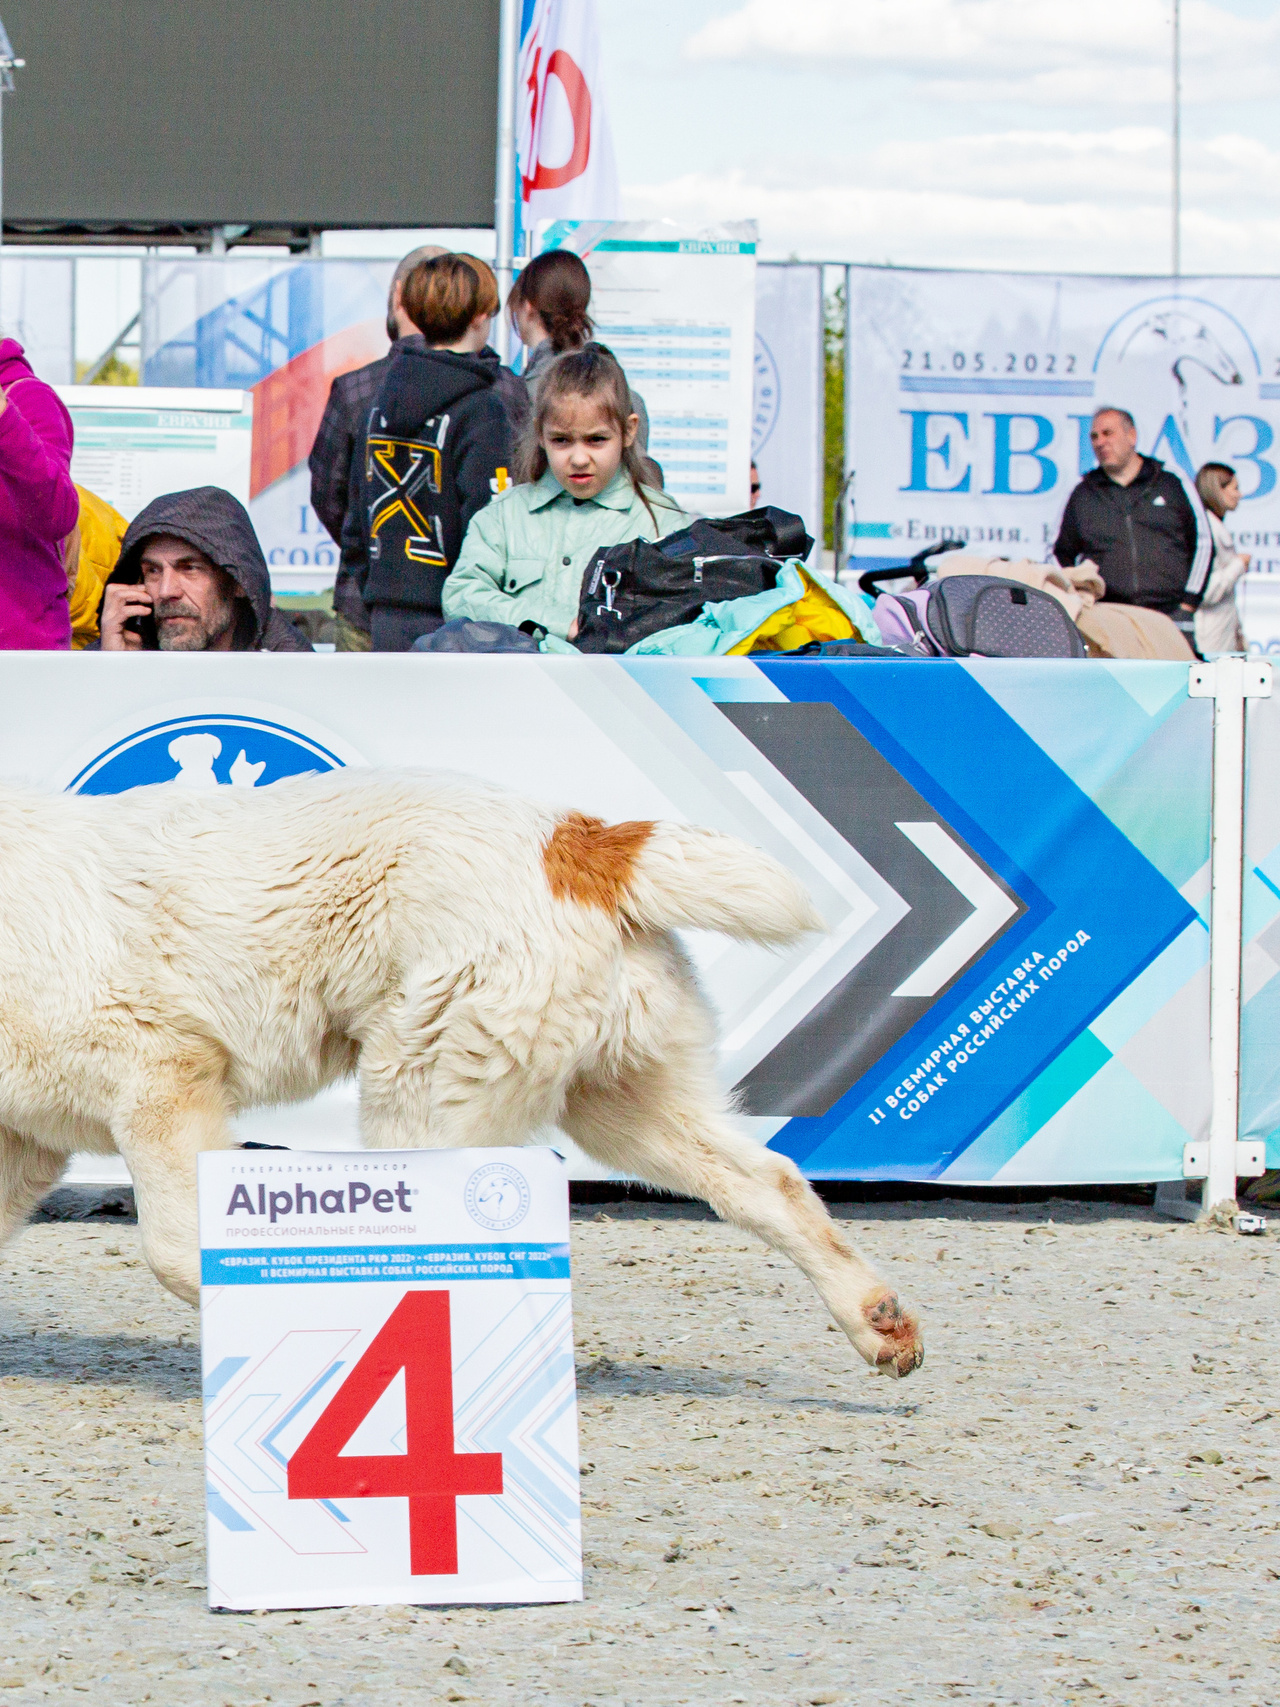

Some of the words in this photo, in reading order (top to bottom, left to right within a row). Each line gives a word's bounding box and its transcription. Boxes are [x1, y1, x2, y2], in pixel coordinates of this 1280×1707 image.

[901, 349, 1078, 374] 21.05.2022
[885, 1023, 971, 1109] ВСЕМИРНАЯ
[969, 951, 1046, 1024] ВЫСТАВКА
[899, 1072, 948, 1120] СОБАК
[946, 979, 1040, 1073] РОССИЙСКИХ
[1038, 929, 1091, 981] ПОРОД
[231, 1164, 333, 1174] ГЕНЕРАЛЬНЫЙ
[344, 1164, 408, 1172] СПОНСОР
[226, 1181, 412, 1223] AlphaPet
[226, 1226, 355, 1237] ПРОФЕССИОНАЛЬНЫЕ
[359, 1225, 417, 1237] РАЦИОНЫ
[220, 1256, 270, 1267] «ЕВРАЗИЯ.
[271, 1256, 304, 1266] КУБОК
[305, 1255, 367, 1266] ПРЕЗИДЕНТА
[368, 1254, 390, 1264] РКФ
[391, 1253, 415, 1263] 2022»
[424, 1252, 473, 1263] «ЕВРАЗИЯ.
[475, 1251, 507, 1262] КУБОК
[509, 1251, 526, 1261] СНГ
[270, 1267, 328, 1278] ВСЕМИРНАЯ
[329, 1266, 381, 1277] ВЫСТАВКА
[382, 1265, 413, 1275] СОБАК
[415, 1263, 478, 1275] РОССИЙСКИХ
[480, 1263, 514, 1274] ПОРОД
[287, 1290, 504, 1576] 4
